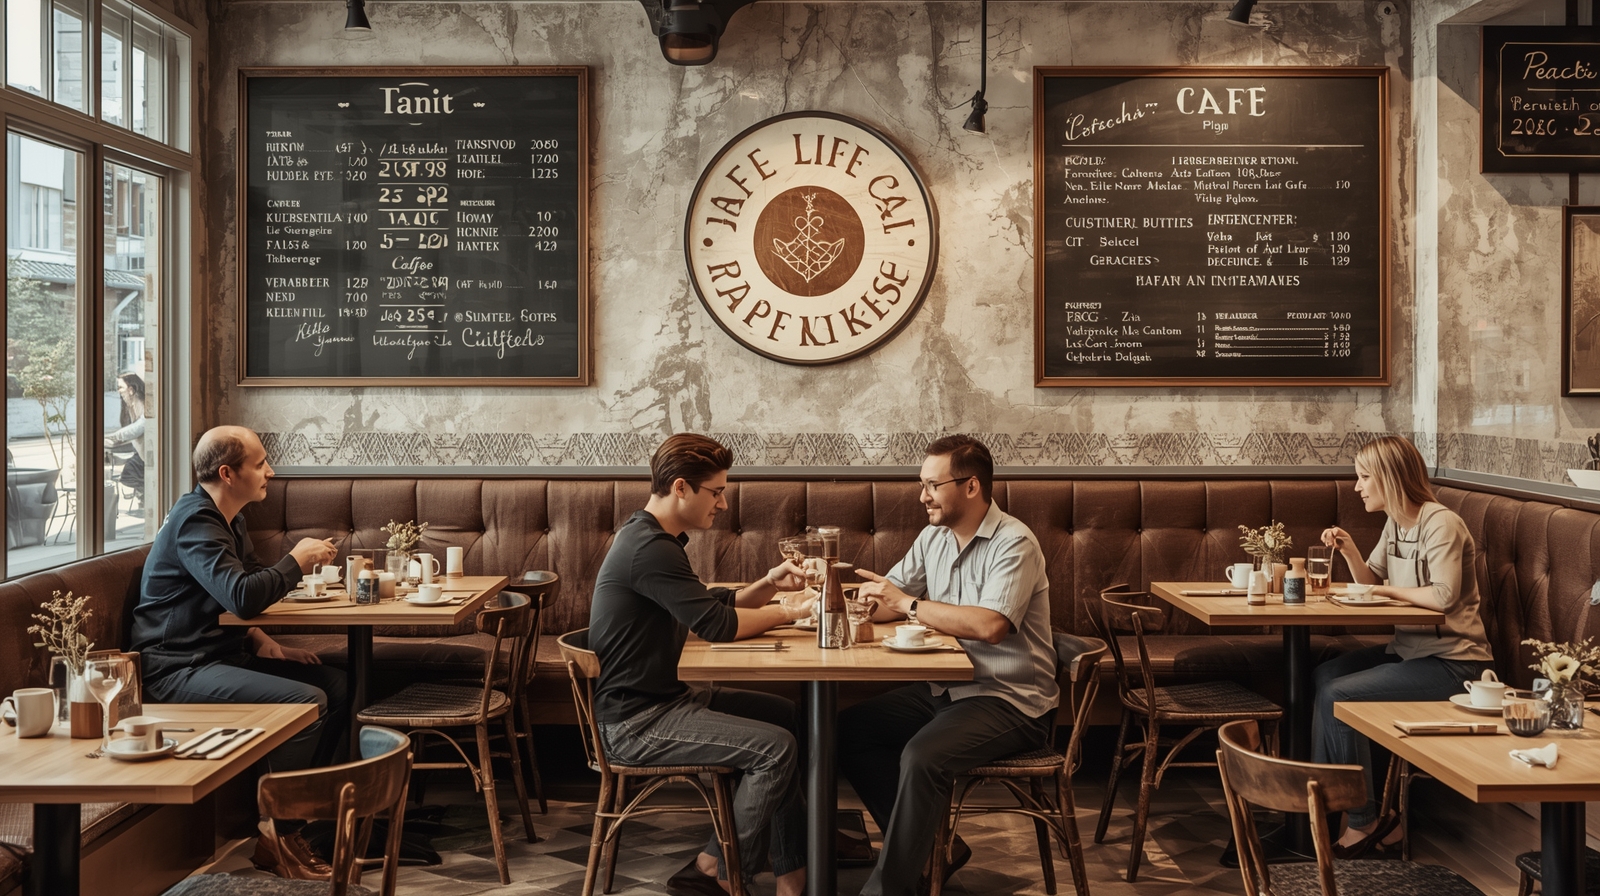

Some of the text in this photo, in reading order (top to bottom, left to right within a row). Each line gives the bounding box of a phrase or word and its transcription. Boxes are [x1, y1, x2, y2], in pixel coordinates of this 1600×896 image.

[379, 87, 454, 115] Tanit
[1176, 86, 1267, 117] CAFE
[792, 133, 869, 178] LIFE
